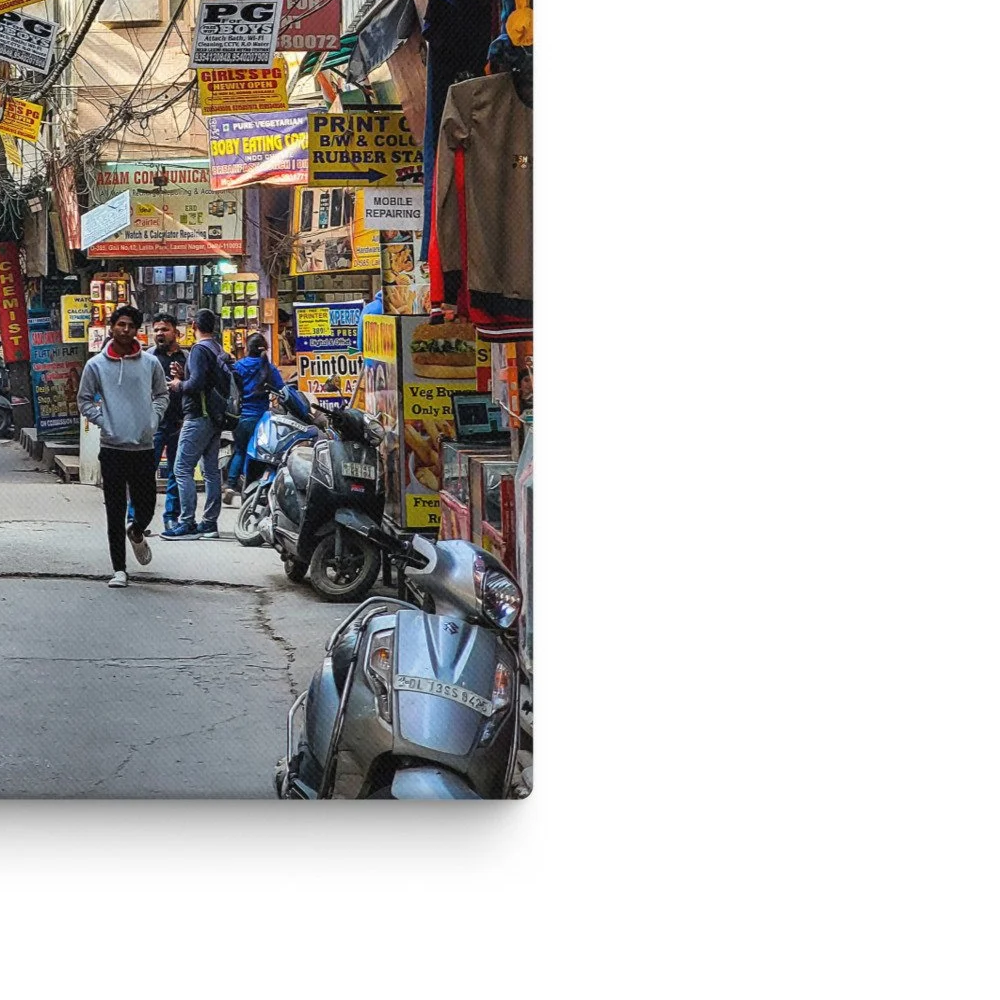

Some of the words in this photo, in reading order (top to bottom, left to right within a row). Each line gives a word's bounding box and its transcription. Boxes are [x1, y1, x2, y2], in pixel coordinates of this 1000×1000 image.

[203, 3, 274, 23] PG
[218, 24, 273, 34] BOYS
[201, 69, 258, 82] GIRLS'S
[262, 68, 282, 79] PG
[213, 82, 246, 91] NEWLY
[248, 81, 273, 89] OPEN
[233, 122, 253, 130] PURE
[255, 118, 304, 129] VEGETARIAN
[314, 116, 390, 132] PRINT
[242, 134, 283, 154] EATING
[356, 135, 368, 147] &
[313, 151, 387, 163] RUBBER
[97, 171, 129, 185] AZAM
[373, 197, 413, 206] MOBILE
[365, 208, 421, 219] REPAIRING
[125, 230, 142, 239] Watch
[300, 355, 363, 376] PrintOut
[409, 386, 434, 400] Veg
[412, 404, 440, 416] Only
